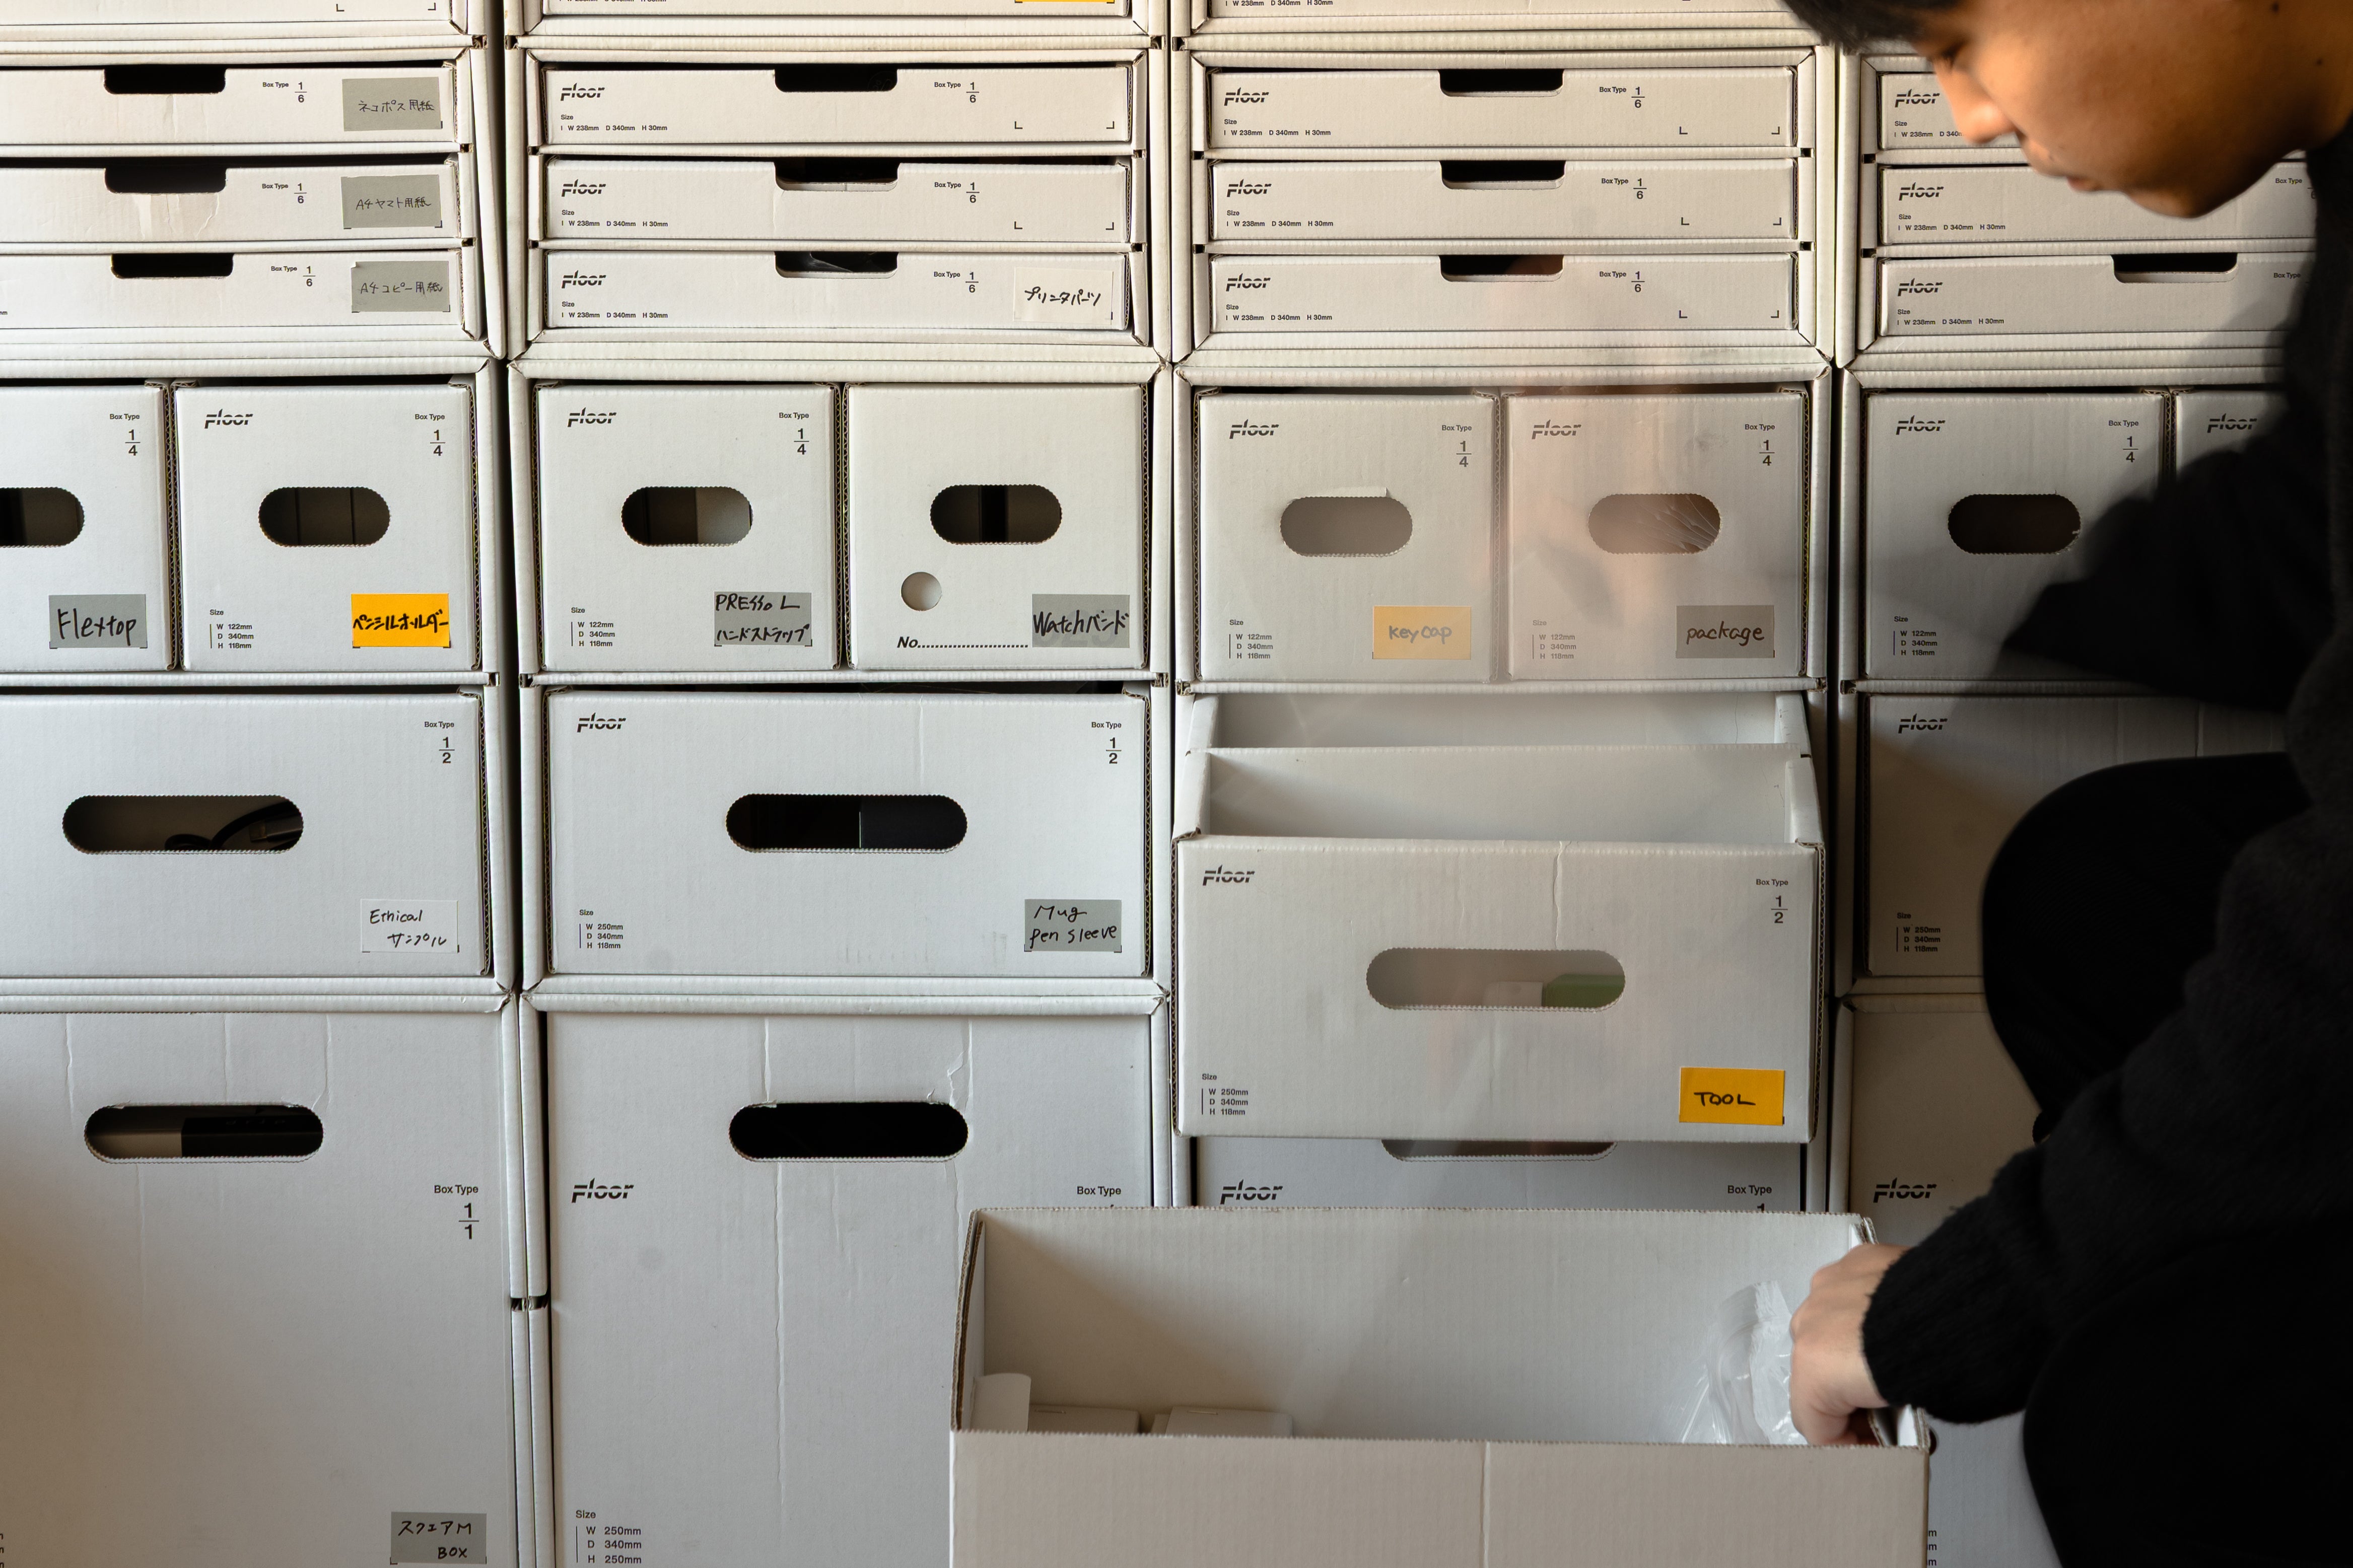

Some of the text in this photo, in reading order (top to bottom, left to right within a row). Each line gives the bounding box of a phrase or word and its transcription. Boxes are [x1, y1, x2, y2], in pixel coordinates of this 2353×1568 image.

[298, 82, 303, 90] 1
[560, 83, 605, 101] Floor
[1635, 86, 1640, 96] 1
[298, 94, 305, 103] 6
[1224, 87, 1270, 106] Floor
[1634, 99, 1642, 108] 6
[1895, 89, 1940, 108] Floor
[561, 179, 606, 197] Floor
[970, 182, 975, 191] 1
[1226, 179, 1272, 198] Floor
[1898, 182, 1944, 201] Floor
[970, 194, 977, 203] 6
[561, 270, 606, 289] Floor
[1225, 273, 1271, 292] Floor
[2286, 272, 2301, 280] Type
[1897, 277, 1943, 297] Floor
[204, 408, 253, 429] Floor
[567, 407, 617, 427] Floor
[793, 412, 809, 420] Type
[2207, 413, 2258, 434] Floor
[1229, 418, 1279, 440] Floor
[1531, 419, 1582, 440] Floor
[1759, 423, 1775, 432] Type
[1896, 415, 1946, 436] Floor
[434, 429, 440, 441] 1
[433, 445, 443, 457] 4
[1763, 439, 1769, 451] 1
[1762, 455, 1772, 466] 4
[57, 608, 136, 647] Flextop
[1686, 620, 1765, 647] package
[438, 721, 455, 729] Type
[577, 712, 627, 733] Floor
[1105, 722, 1122, 730] Type
[1898, 713, 1948, 734] Floor
[1202, 865, 1255, 886] Floor
[1771, 879, 1789, 887] Type
[1775, 895, 1782, 907] 1
[370, 908, 423, 924] Ethical
[1033, 905, 1087, 923] Mug
[1774, 911, 1783, 923] 2
[387, 933, 447, 948] サンプル
[1029, 925, 1117, 949] pen sleeve
[434, 1184, 479, 1196] Box Type
[571, 1178, 634, 1203] Floor
[1077, 1186, 1122, 1197] Box Type
[1220, 1179, 1283, 1205] Floor
[1727, 1184, 1772, 1196] Box Type
[1873, 1177, 1937, 1203] Floor
[464, 1202, 472, 1219] 1
[464, 1224, 472, 1240] 1
[576, 1510, 596, 1519] Size
[586, 1526, 641, 1535] W 250mm
[438, 1546, 467, 1559] BOX
[587, 1540, 642, 1549] D 340mm
[588, 1554, 642, 1564] H 250mm
